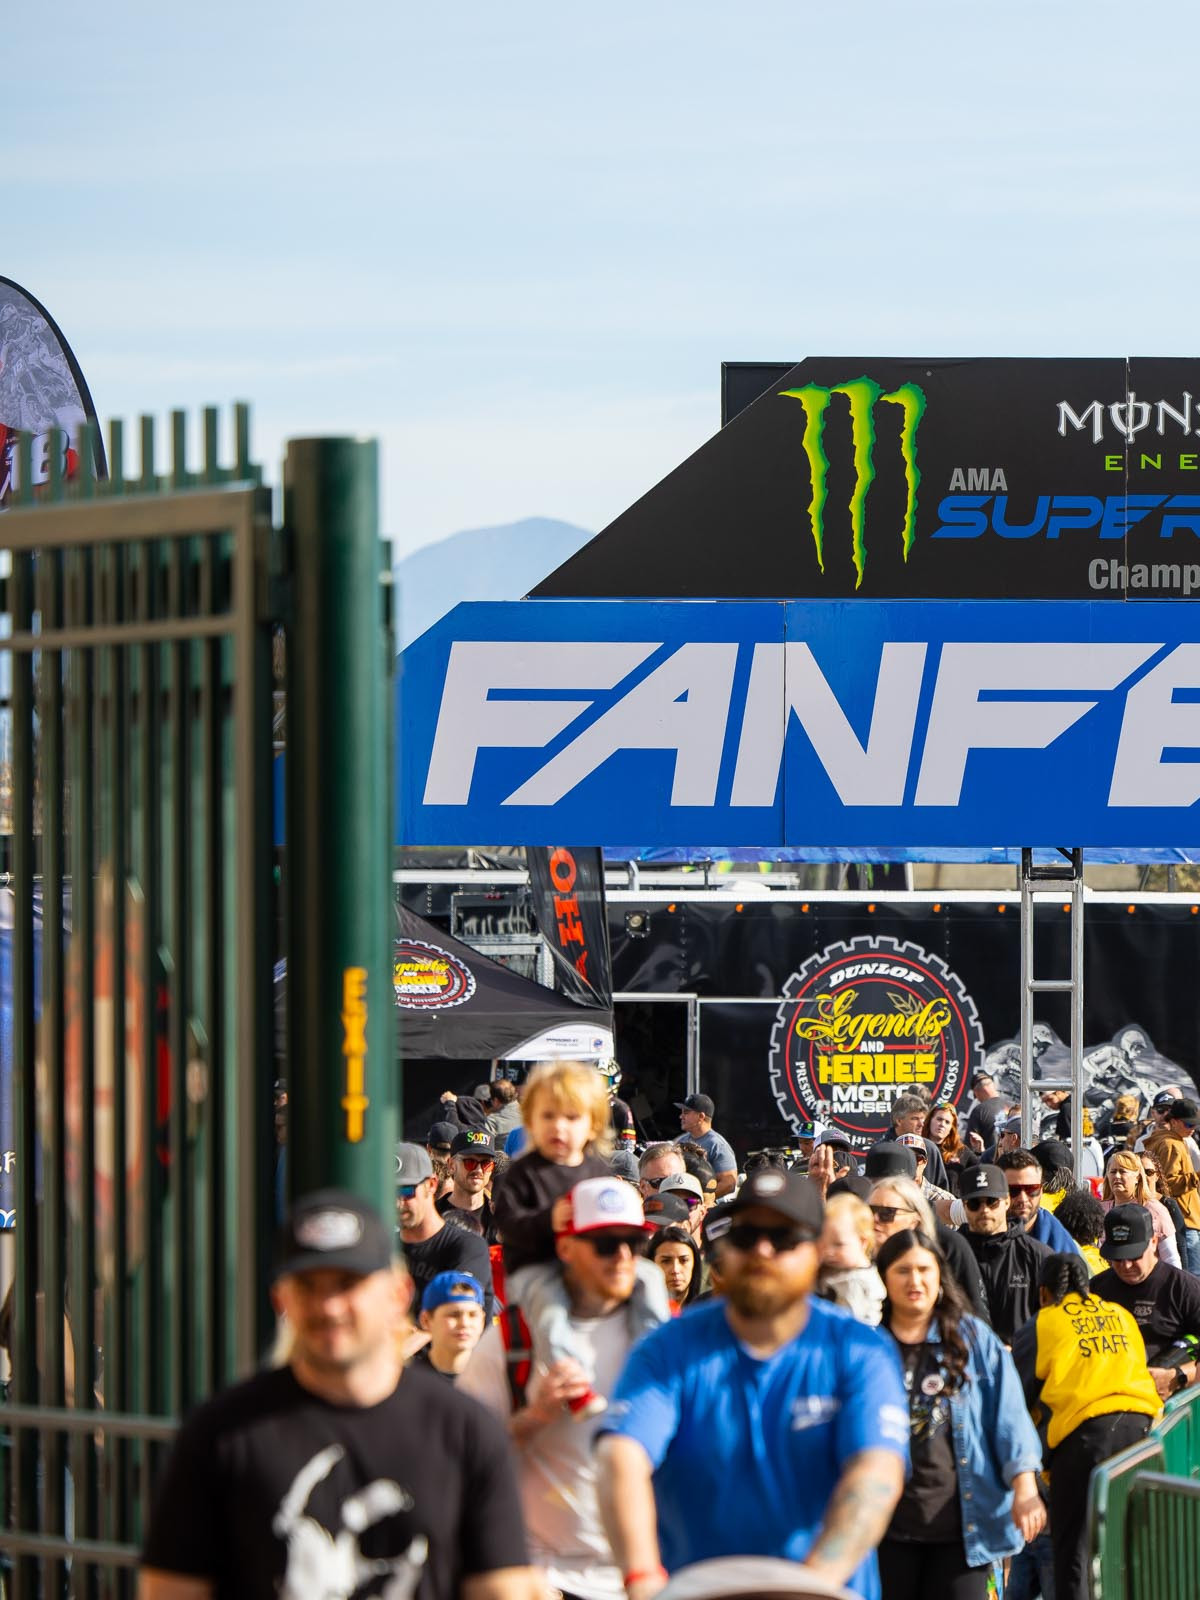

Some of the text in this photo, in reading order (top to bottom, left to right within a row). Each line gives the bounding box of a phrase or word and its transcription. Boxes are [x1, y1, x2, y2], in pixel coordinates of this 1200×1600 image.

[949, 468, 1008, 491] AMA
[829, 963, 925, 987] DUNLOP
[795, 989, 952, 1052] Legends
[341, 966, 370, 1144] EXIT
[860, 1041, 885, 1053] AND
[818, 1054, 937, 1084] HEROES
[832, 1102, 892, 1113] MUSE
[467, 1131, 491, 1146] Sorry
[1063, 1299, 1116, 1316] CSC
[1071, 1315, 1125, 1336] SECURITY
[1078, 1334, 1129, 1358] STAFF
